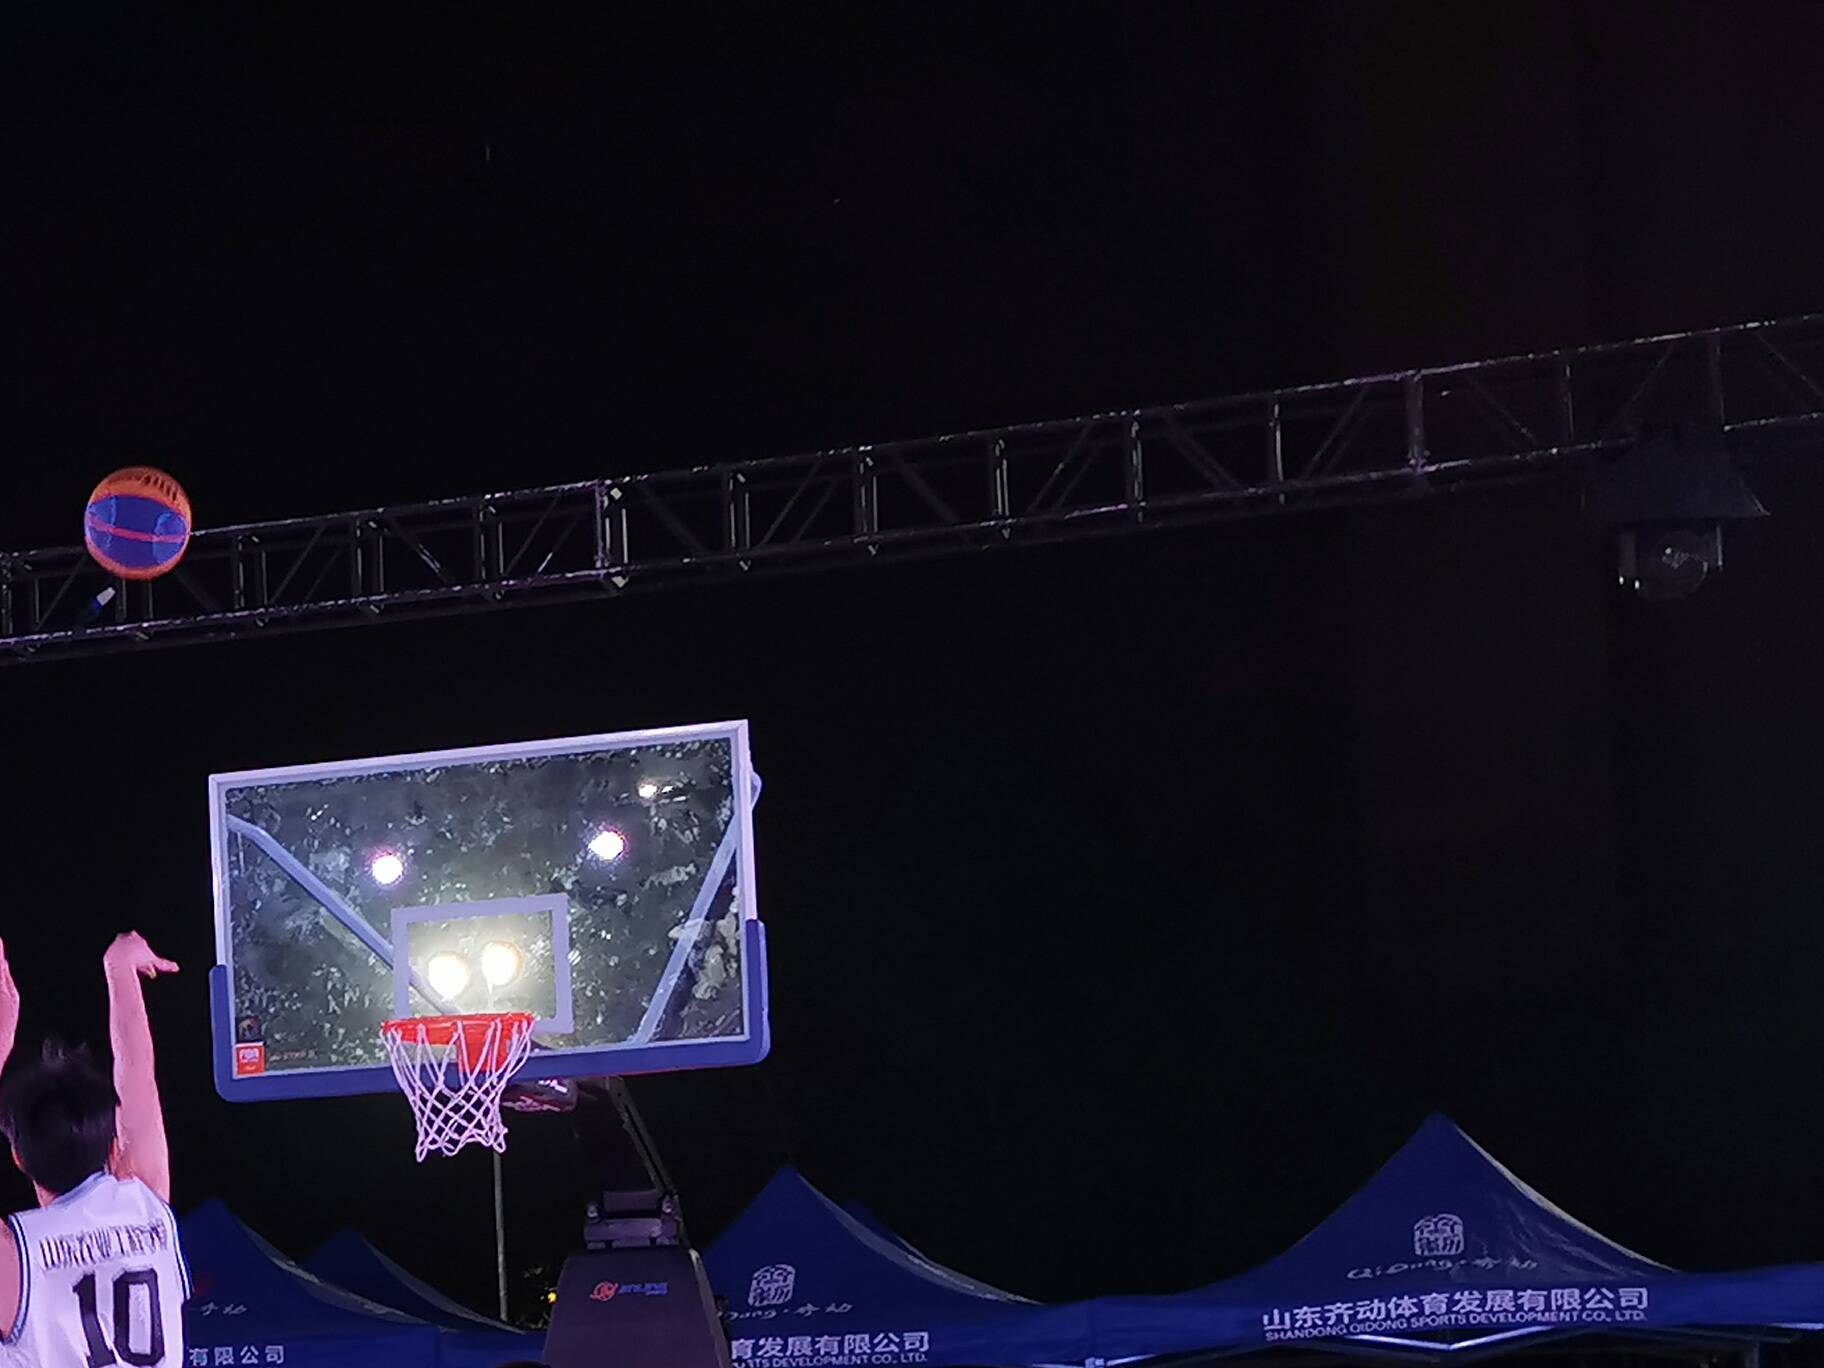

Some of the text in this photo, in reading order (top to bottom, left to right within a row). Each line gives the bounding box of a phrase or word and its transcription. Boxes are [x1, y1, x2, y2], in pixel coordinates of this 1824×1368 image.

[1262, 1286, 1648, 1331] 山东齐动体育发展有限公司
[1265, 1324, 1348, 1342] SHANDONG
[1349, 1318, 1408, 1334] QIDONG
[1410, 1314, 1467, 1327] SPORTS
[1469, 1310, 1578, 1325] DEVELOPMENT
[189, 1344, 285, 1367] 有限公司
[773, 1354, 869, 1368] DEVELOPMENT
